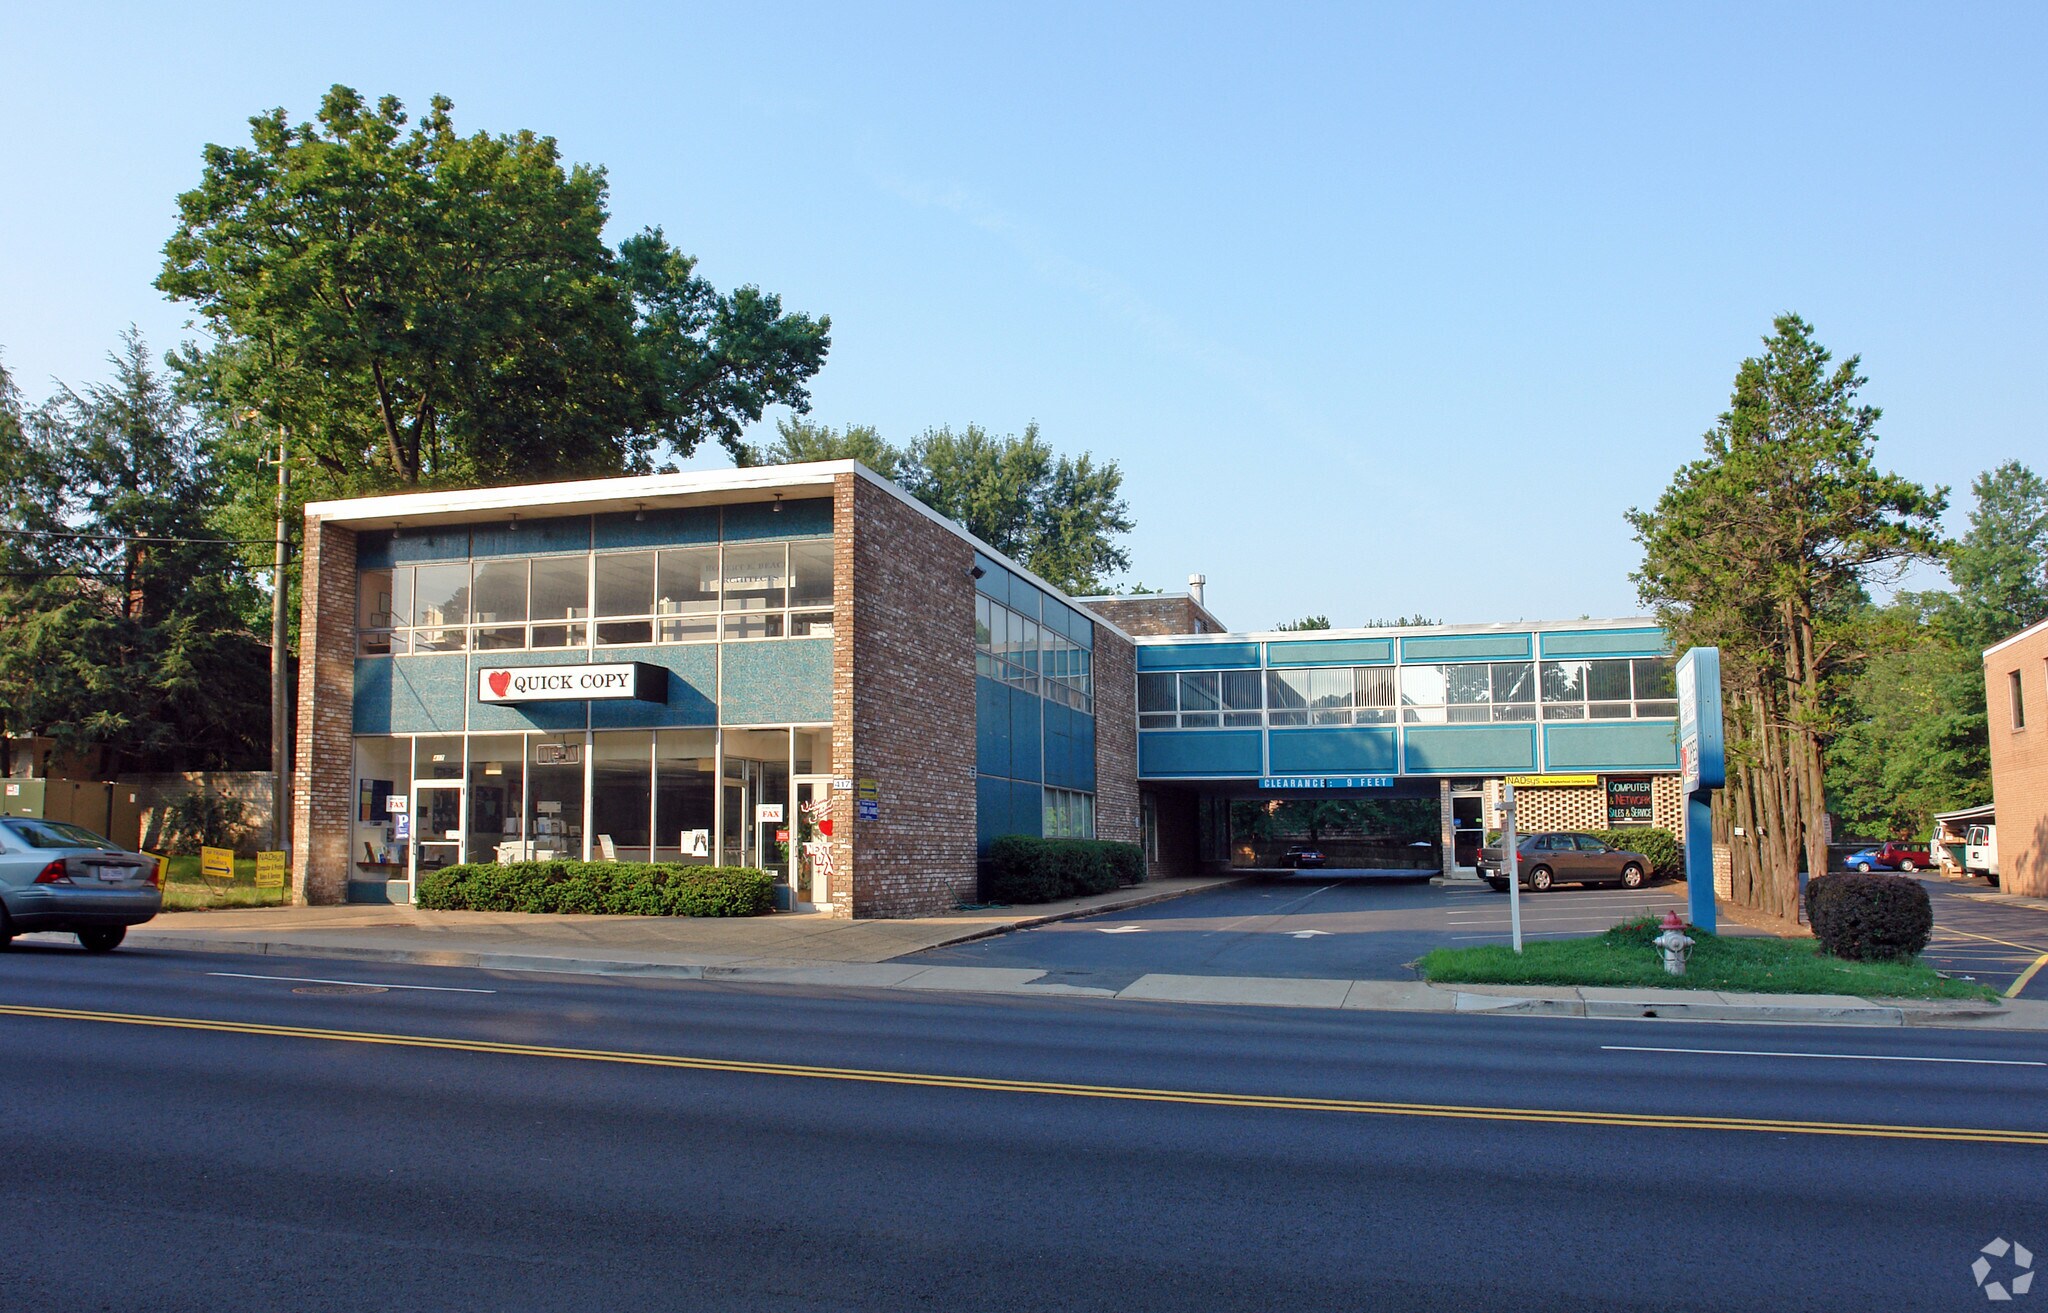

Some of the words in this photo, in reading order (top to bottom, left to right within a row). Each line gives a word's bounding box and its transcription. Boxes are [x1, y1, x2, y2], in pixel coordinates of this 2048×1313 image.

[514, 675, 573, 693] QUICK
[580, 673, 629, 688] COPY
[1346, 779, 1352, 787] 9
[1360, 778, 1386, 787] FEET
[1507, 776, 1540, 786] NADsys
[1608, 782, 1650, 792] COMPUTER
[1609, 796, 1614, 805] &
[1615, 794, 1651, 805] NETWORK
[1609, 807, 1624, 817] SALES
[1625, 808, 1630, 817] &
[1631, 806, 1652, 817] SERVICE
